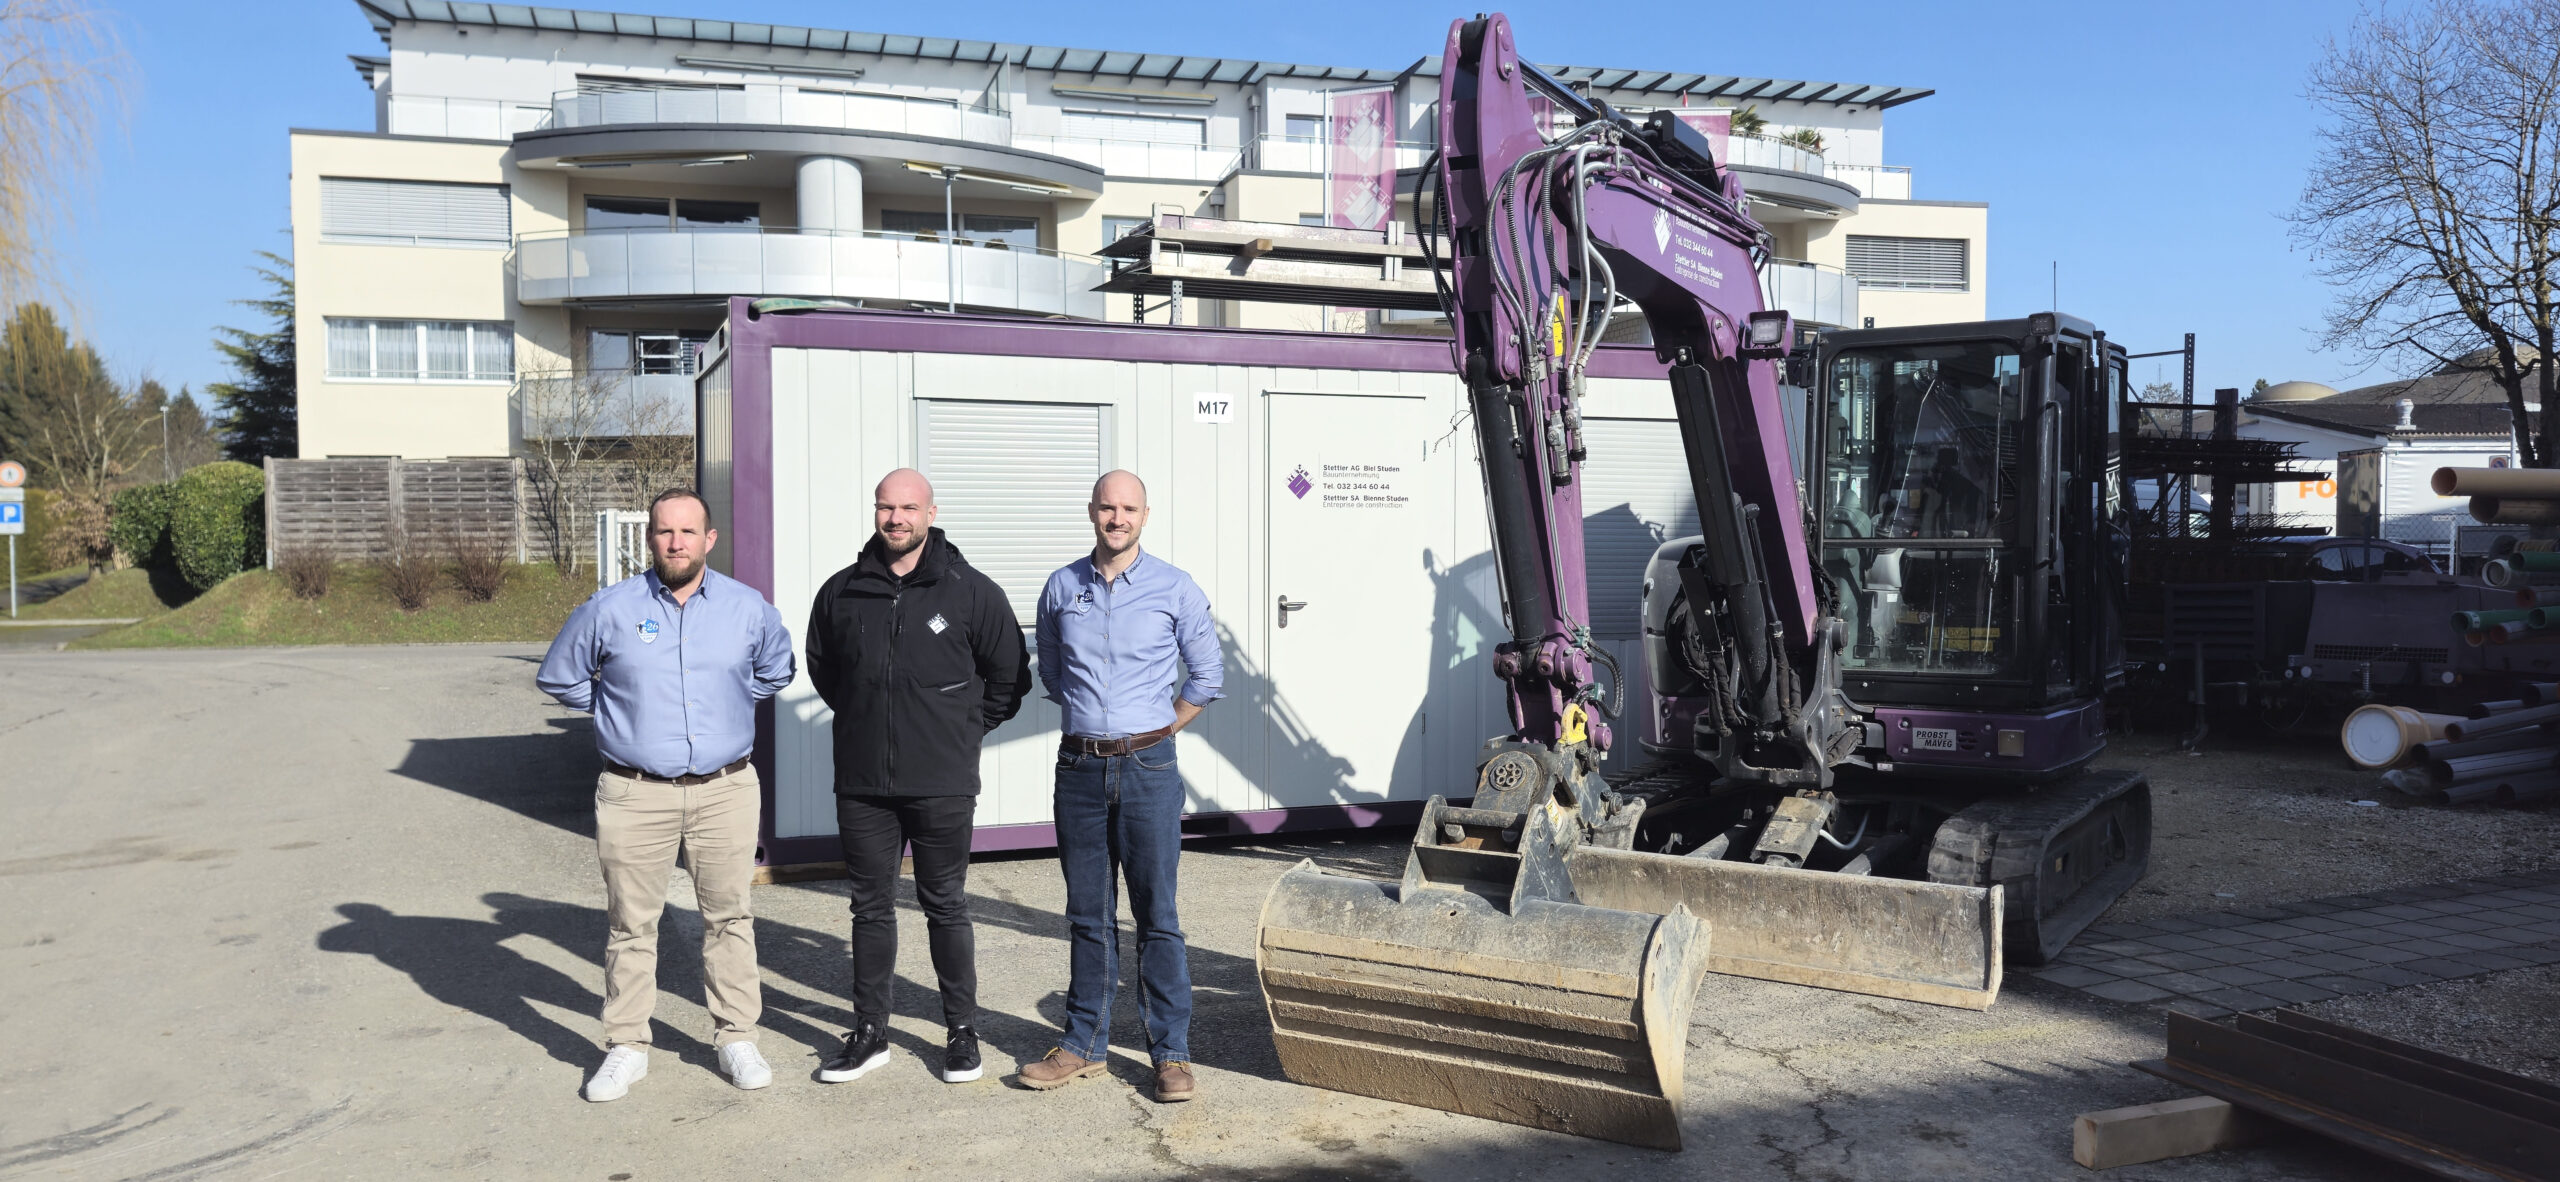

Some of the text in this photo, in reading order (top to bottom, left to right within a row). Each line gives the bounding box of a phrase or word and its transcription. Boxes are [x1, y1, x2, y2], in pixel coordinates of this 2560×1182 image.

[1198, 400, 1229, 415] M17
[1377, 465, 1400, 473] Studen
[1323, 471, 1379, 479] Bauunternehmung
[1352, 483, 1367, 491] 344
[1368, 483, 1379, 491] 60
[1350, 494, 1360, 502] SA
[3, 505, 17, 522] P
[647, 622, 659, 631] 26
[1916, 731, 1948, 739] PROBST
[1924, 739, 1952, 748] MAVEG
